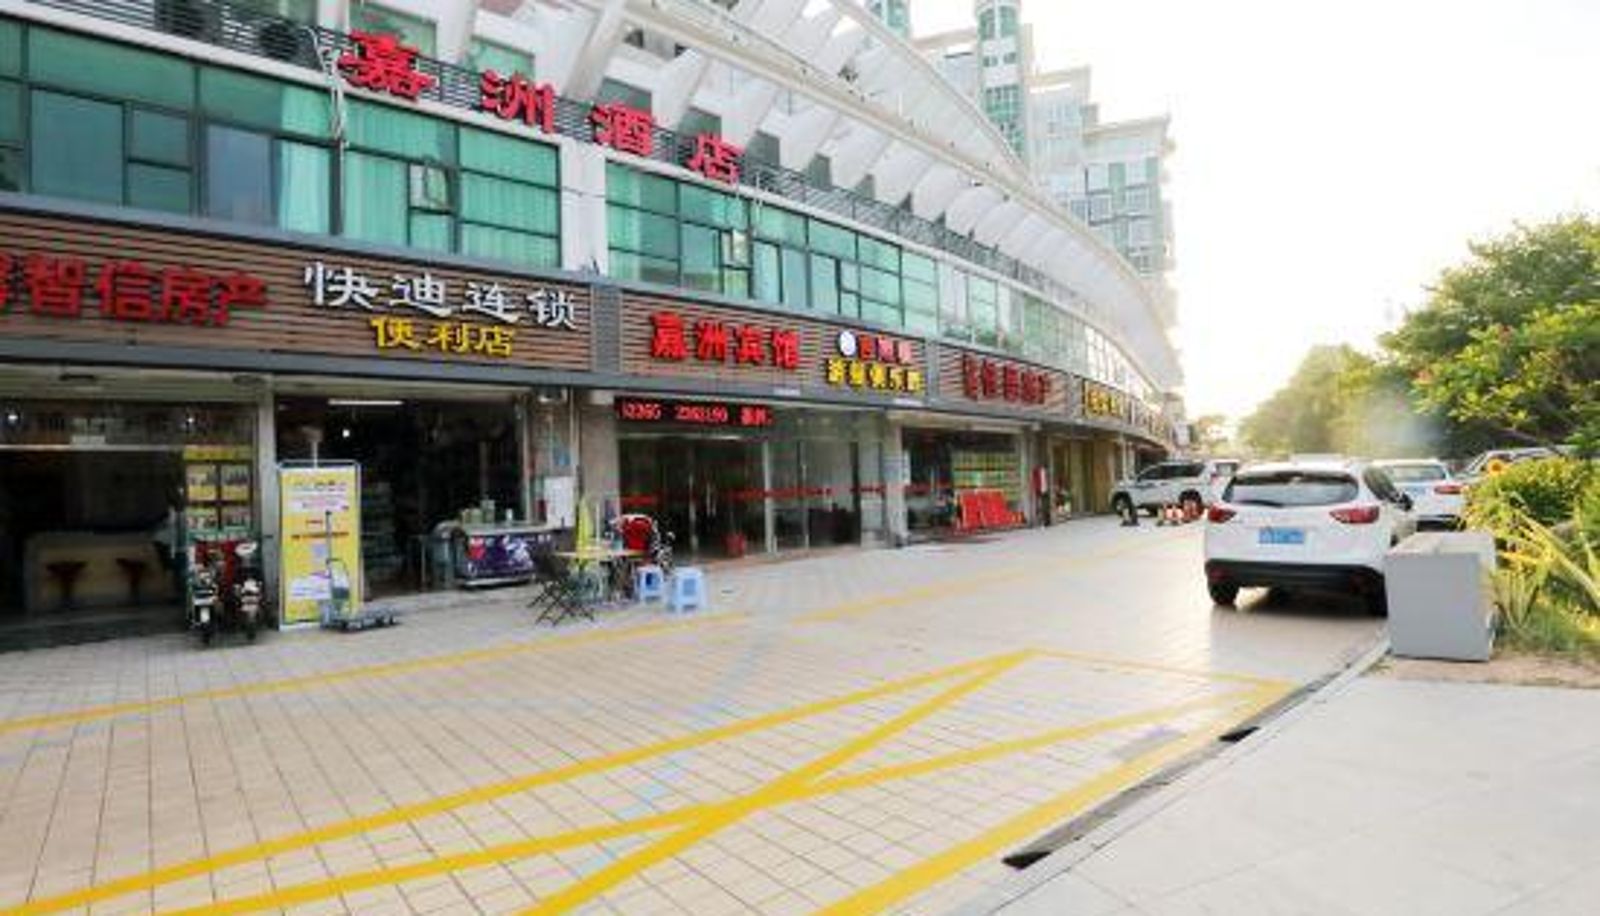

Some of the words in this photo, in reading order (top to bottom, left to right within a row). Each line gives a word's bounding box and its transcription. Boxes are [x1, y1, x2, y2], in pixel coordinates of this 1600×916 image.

[337, 29, 745, 184] 嘉洲酒店
[0, 252, 268, 328] 智信房产
[304, 260, 578, 330] 快迪连锁
[369, 314, 515, 358] 便利店
[650, 311, 800, 370] 嘉洲宾馆
